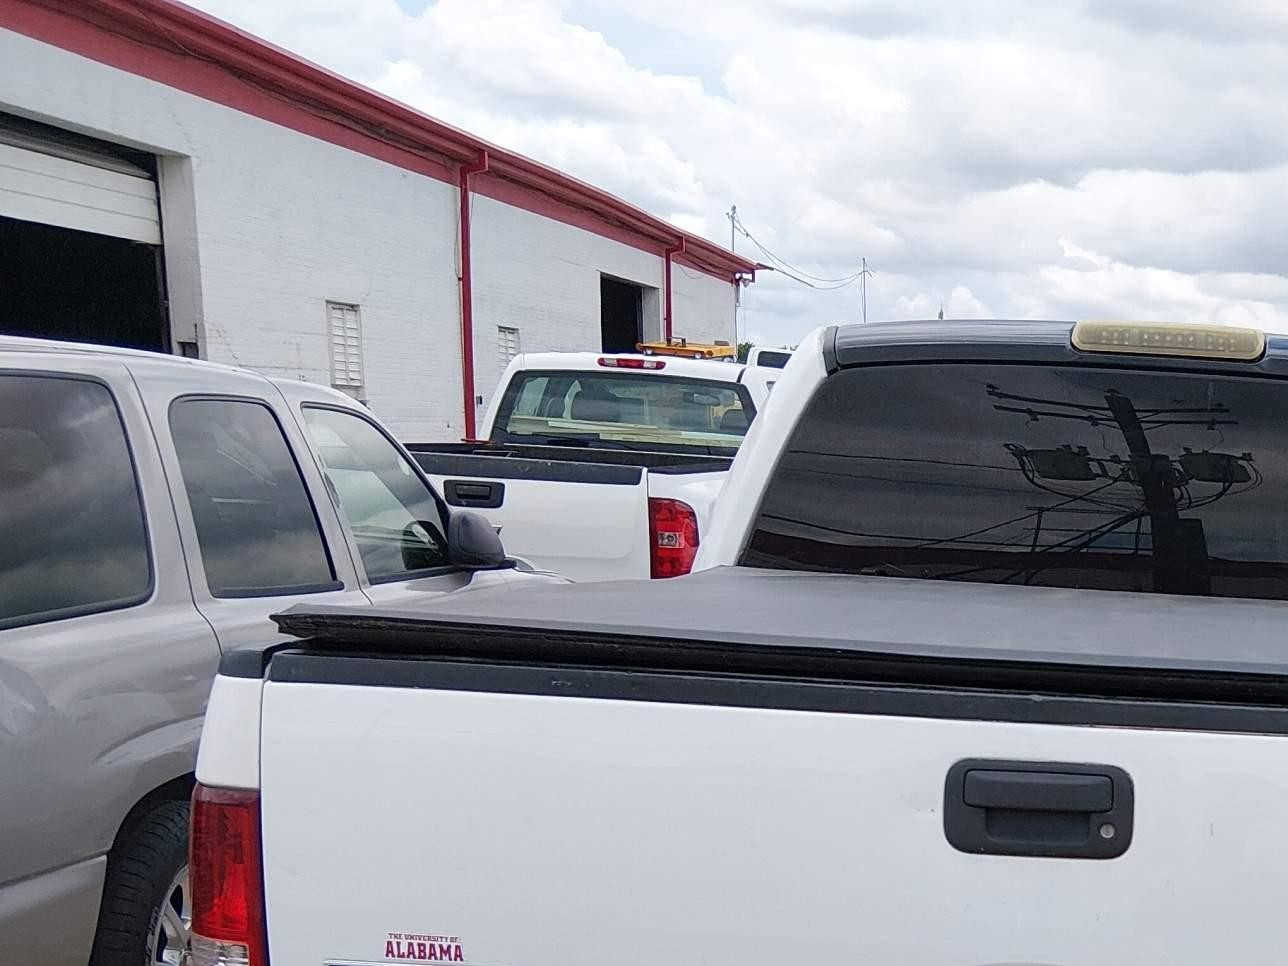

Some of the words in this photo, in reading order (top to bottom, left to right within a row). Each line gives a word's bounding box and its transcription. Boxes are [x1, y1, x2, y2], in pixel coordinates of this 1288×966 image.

[388, 932, 403, 941] THE
[404, 934, 449, 943] UNIVERSITY
[385, 940, 465, 962] ALABAMA
